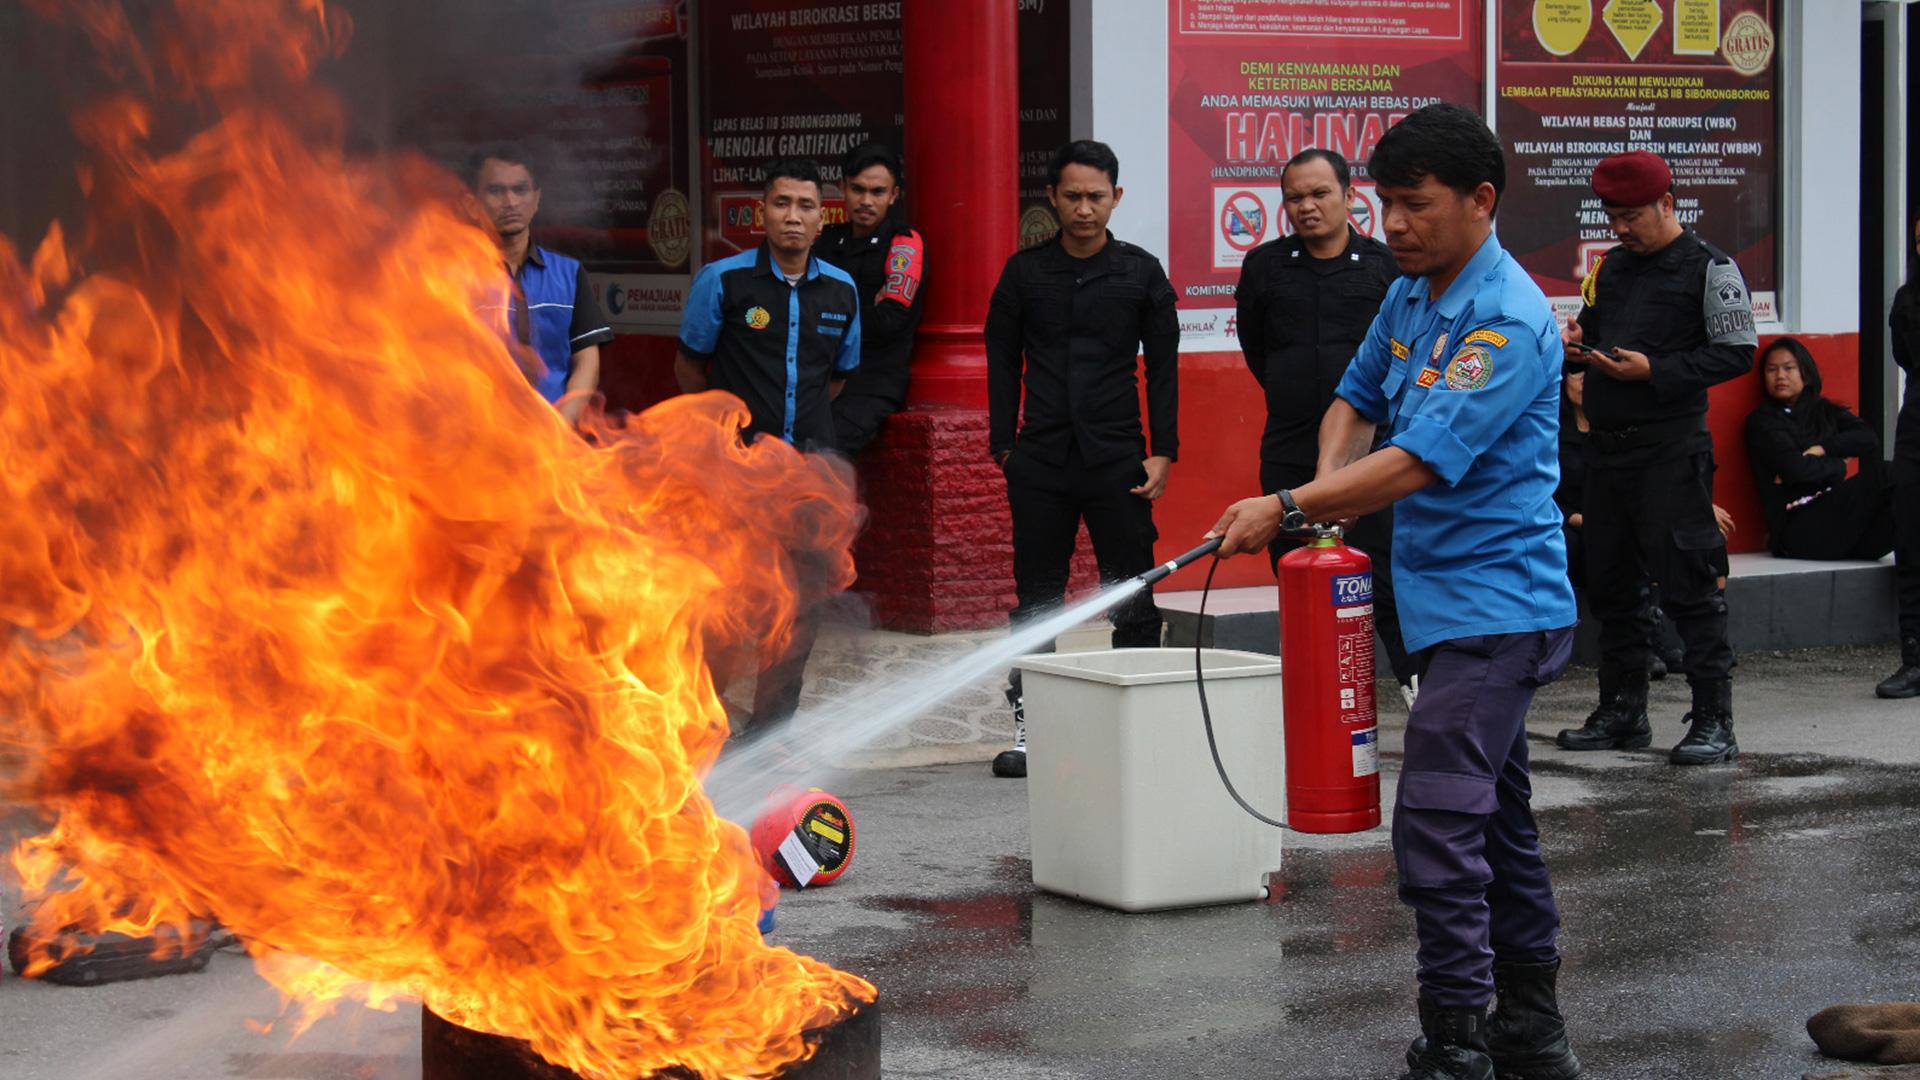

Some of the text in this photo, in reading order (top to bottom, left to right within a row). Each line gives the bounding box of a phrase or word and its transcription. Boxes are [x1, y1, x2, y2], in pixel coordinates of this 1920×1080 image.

[731, 2, 902, 31] WILAYAH BIROKRASI BERSI
[1726, 35, 1770, 55] GRATIS
[1240, 62, 1400, 77] DEMI KENYAMANAN DAN
[1248, 77, 1393, 92] KETERTIBAN BERSAMA
[1571, 75, 1703, 88] DUKUNG KAMI MEWUJUDKAN
[1501, 86, 1770, 100] LEMBAGA PEMASYARAKATAN KELAS IIB SIBORONGBORONG
[1200, 95, 1238, 107] ANDA
[1242, 95, 1310, 109] MEMASUKI
[1312, 96, 1367, 109] WILAYAH
[1370, 96, 1409, 109] BEBAS
[1625, 102, 1655, 113] Menjadi
[713, 112, 862, 132] LAPAS KELAS IIB SIBORONGBORONG
[1541, 115, 1736, 130] WILAYAH BEBAS DARI KORUPSI (WBK)
[1628, 129, 1651, 141] DAN
[1513, 141, 1761, 156] WILAYAH BIROKRASI BERSIH MELAYANI (WBBM)
[1551, 158, 1582, 167] DENGAN
[1211, 165, 1279, 179] (HANDPHONE,
[1527, 167, 1546, 176] PADA
[1547, 167, 1570, 176] SETIAP
[1675, 167, 1693, 176] YANG
[1694, 167, 1713, 176] KAMI
[1714, 168, 1745, 177] BERIKAN
[1581, 199, 1602, 209] LAPAS
[627, 288, 682, 302] PEMAJUAN
